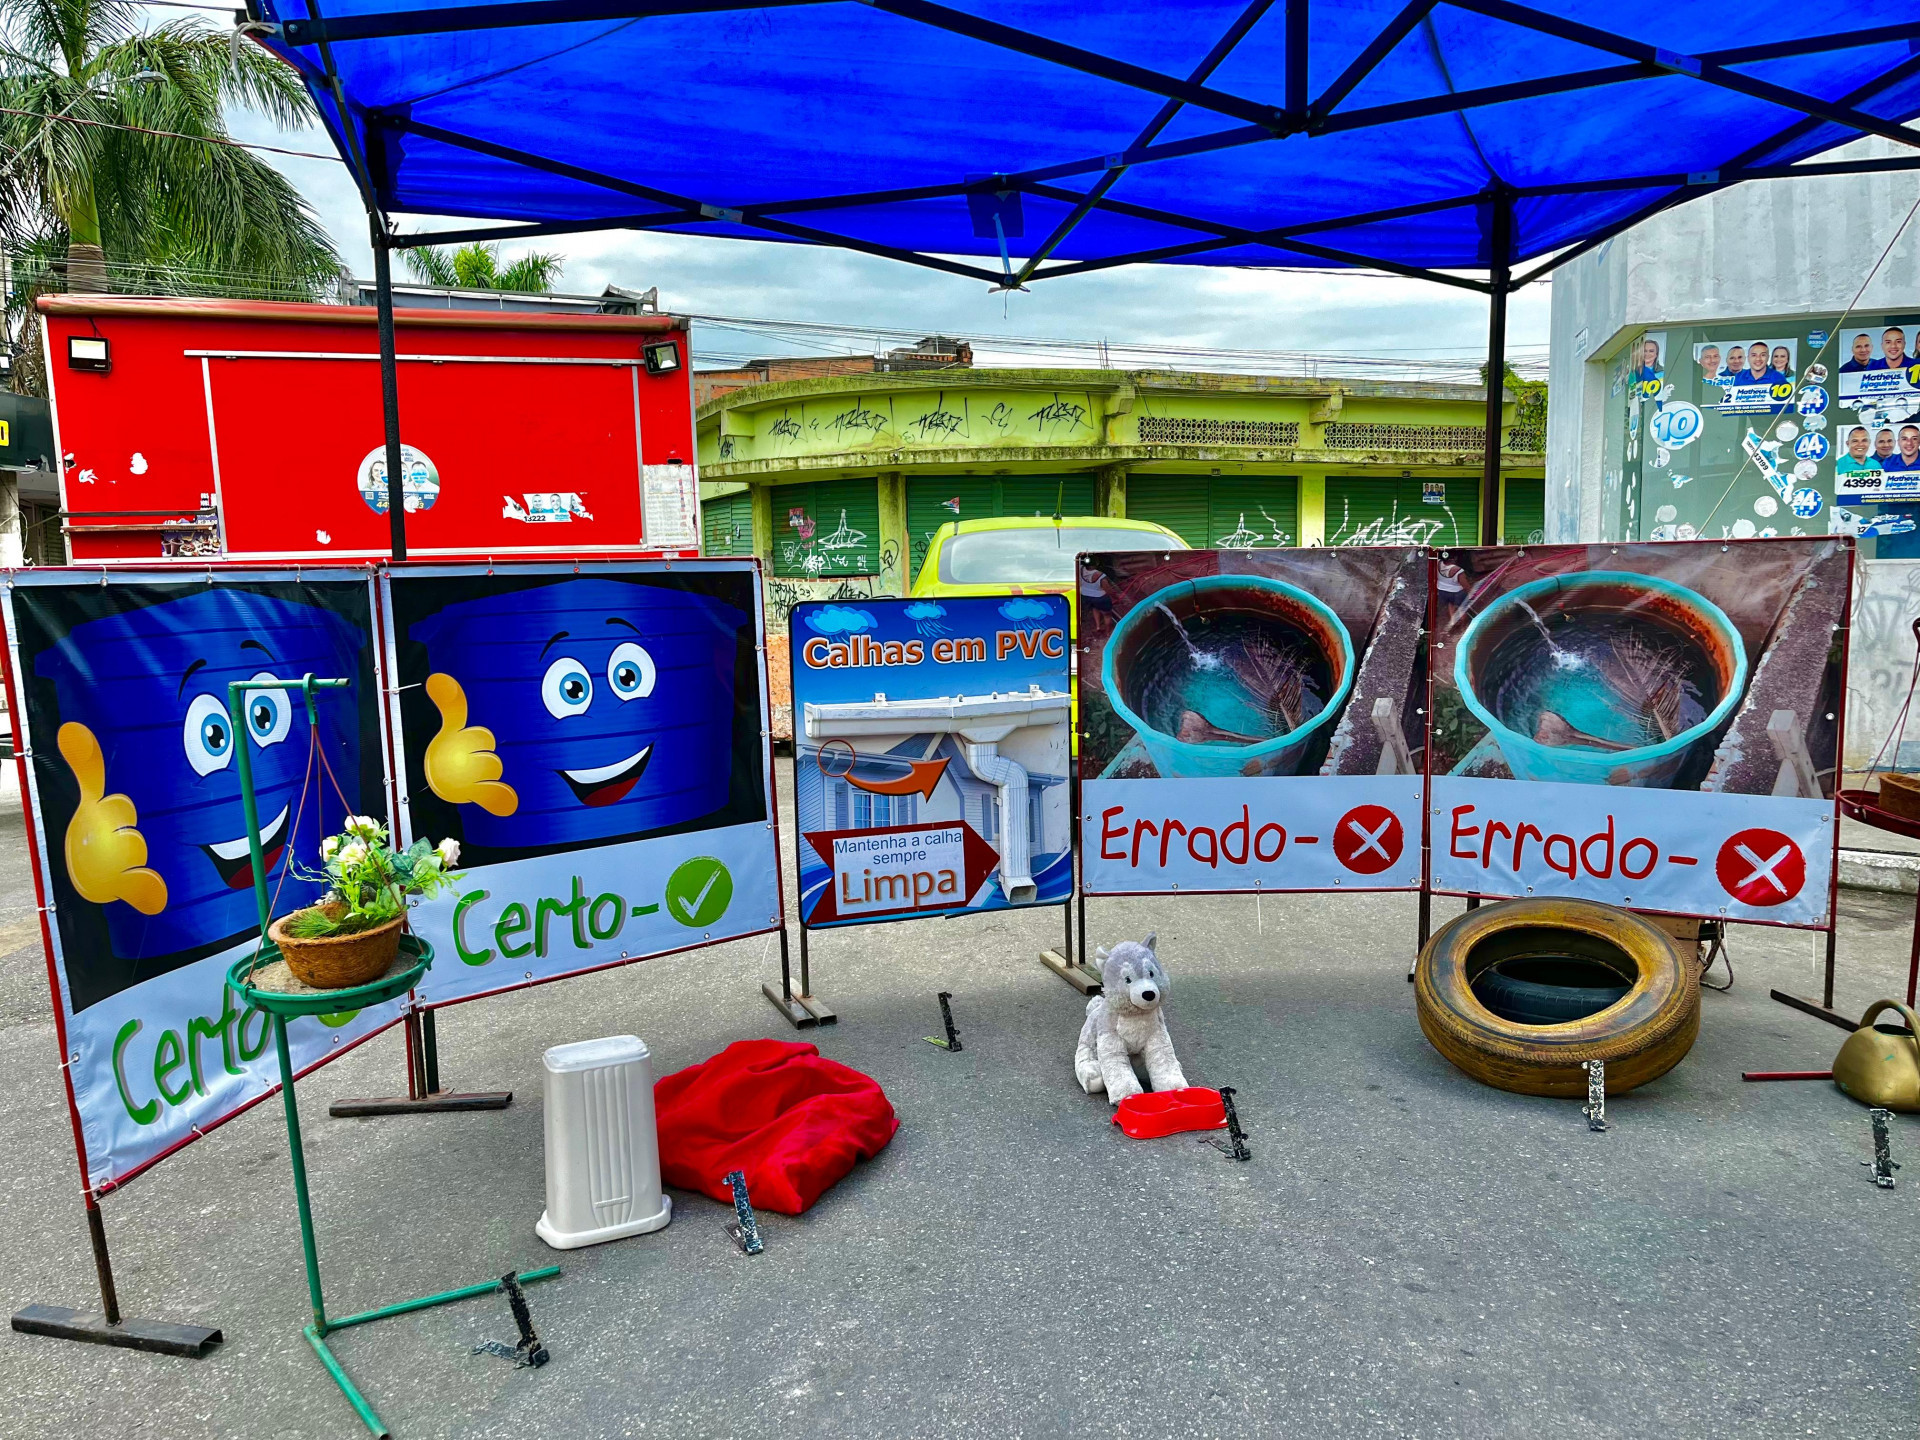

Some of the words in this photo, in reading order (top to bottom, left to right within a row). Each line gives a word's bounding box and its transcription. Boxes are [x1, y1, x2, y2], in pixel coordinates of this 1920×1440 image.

[1642, 380, 1661, 394] 10
[1771, 383, 1792, 398] 10
[1653, 408, 1699, 442] 10
[1797, 433, 1823, 454] 44
[1843, 478, 1882, 488] 43999
[803, 634, 924, 670] Calhas
[931, 636, 988, 664] em
[995, 628, 1064, 662] PVC
[834, 836, 907, 854] Mantenha
[912, 837, 920, 847] a
[924, 829, 963, 846] calha
[872, 849, 927, 865] sempre
[840, 867, 958, 907] Limpa
